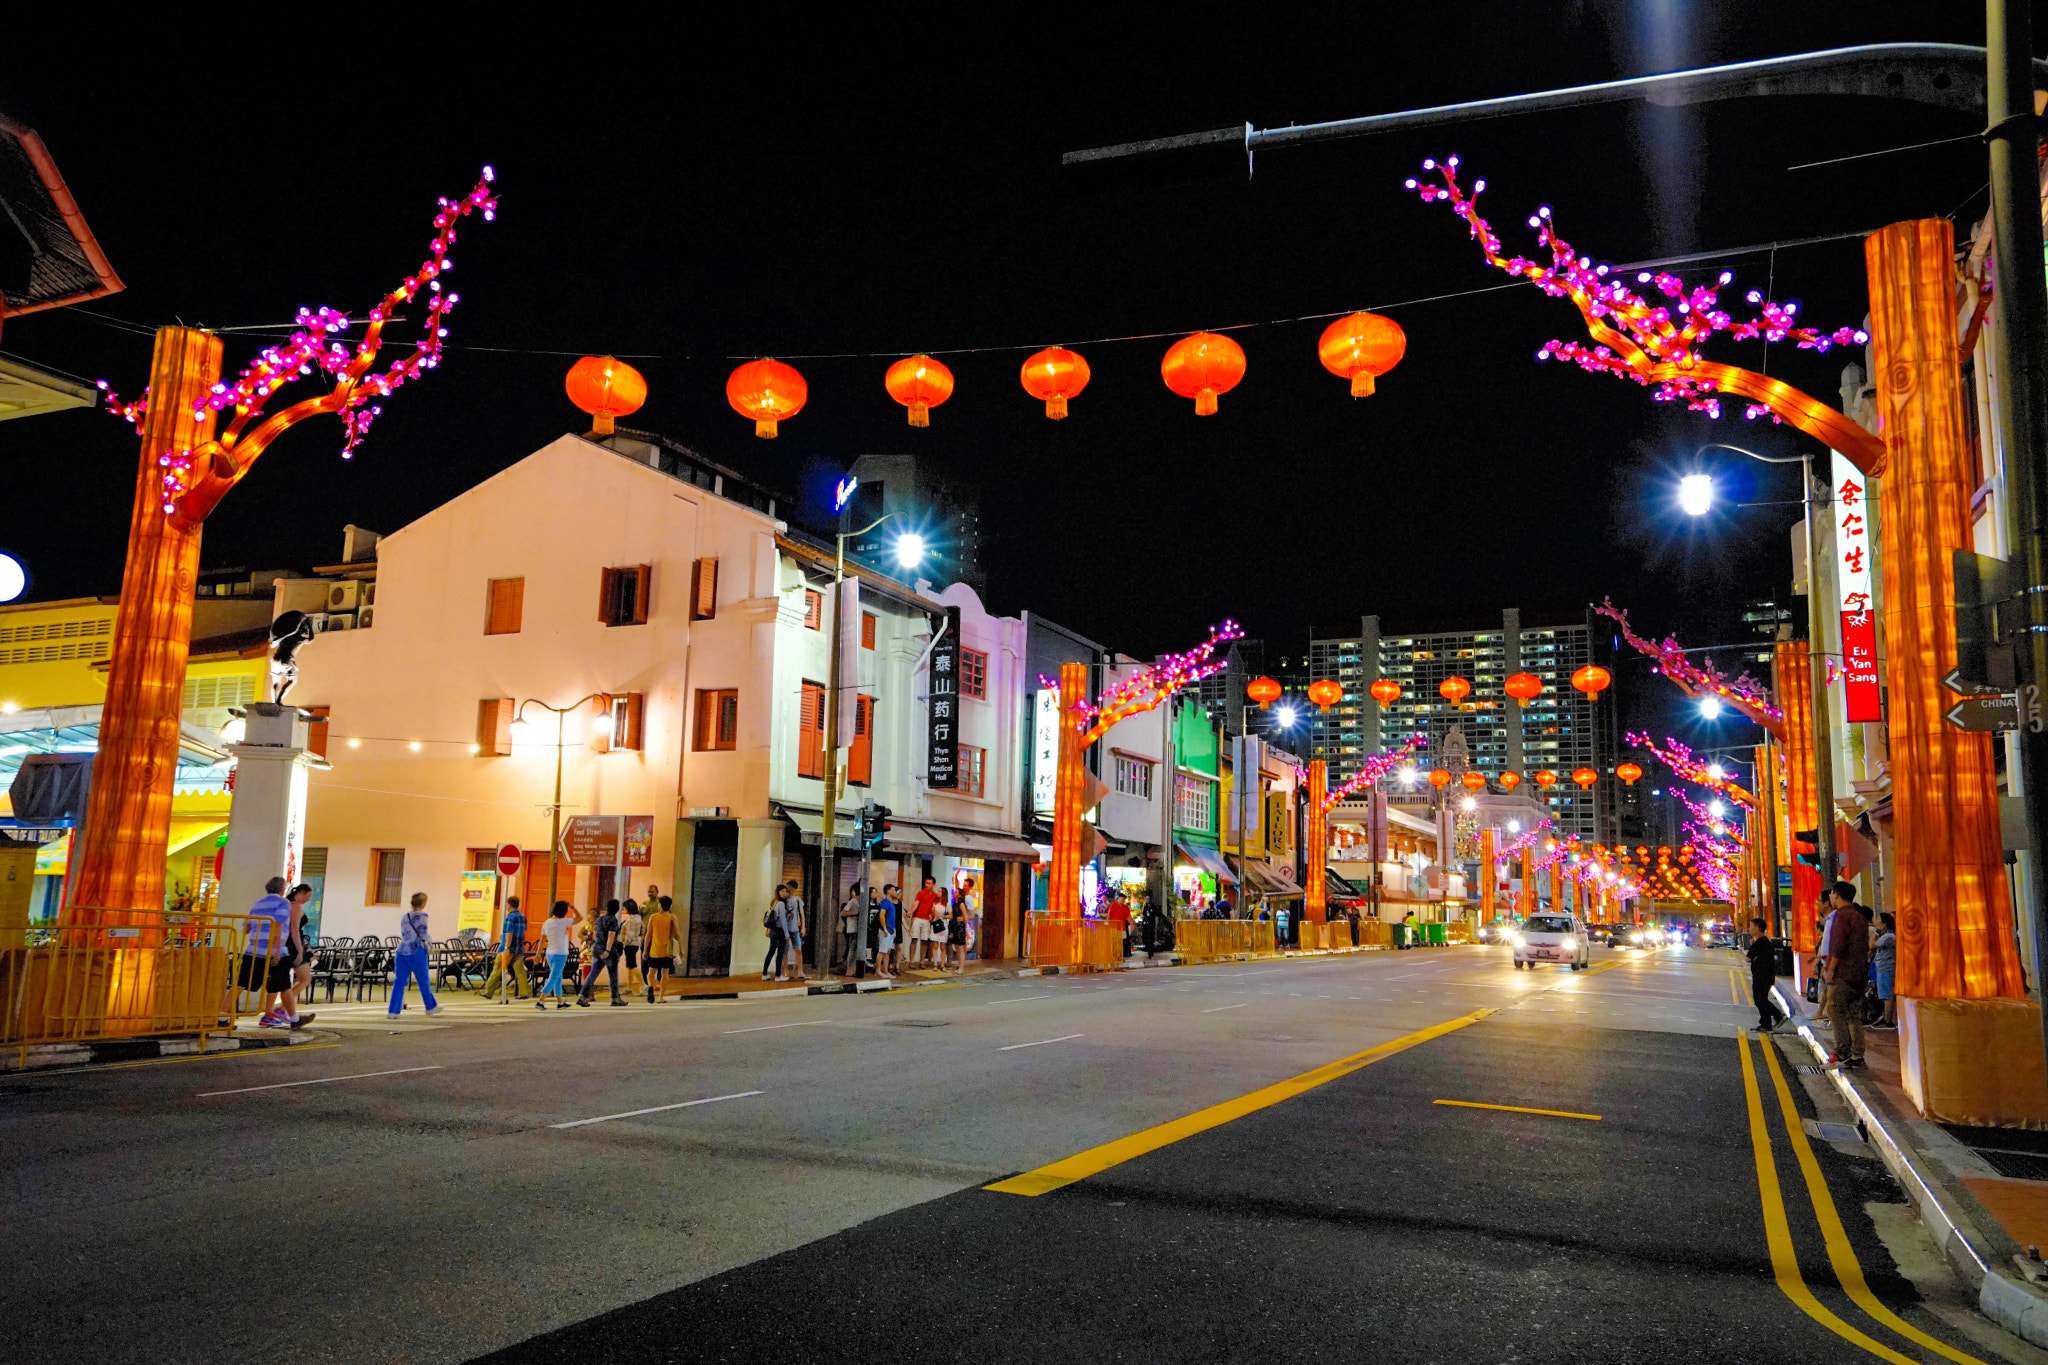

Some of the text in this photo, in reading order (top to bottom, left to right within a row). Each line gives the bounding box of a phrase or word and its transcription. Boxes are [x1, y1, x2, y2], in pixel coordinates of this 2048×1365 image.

[1838, 478, 1865, 574] 余仁生
[1853, 646, 1868, 656] Eu
[1852, 660, 1872, 669] Yan
[1848, 673, 1877, 684] Sang
[934, 655, 951, 740] 泰山药行
[934, 747, 949, 755] Thye
[933, 756, 949, 764] Shan
[930, 764, 953, 772] Medical
[935, 773, 947, 781] Hall
[1273, 802, 1283, 850] TAILORS
